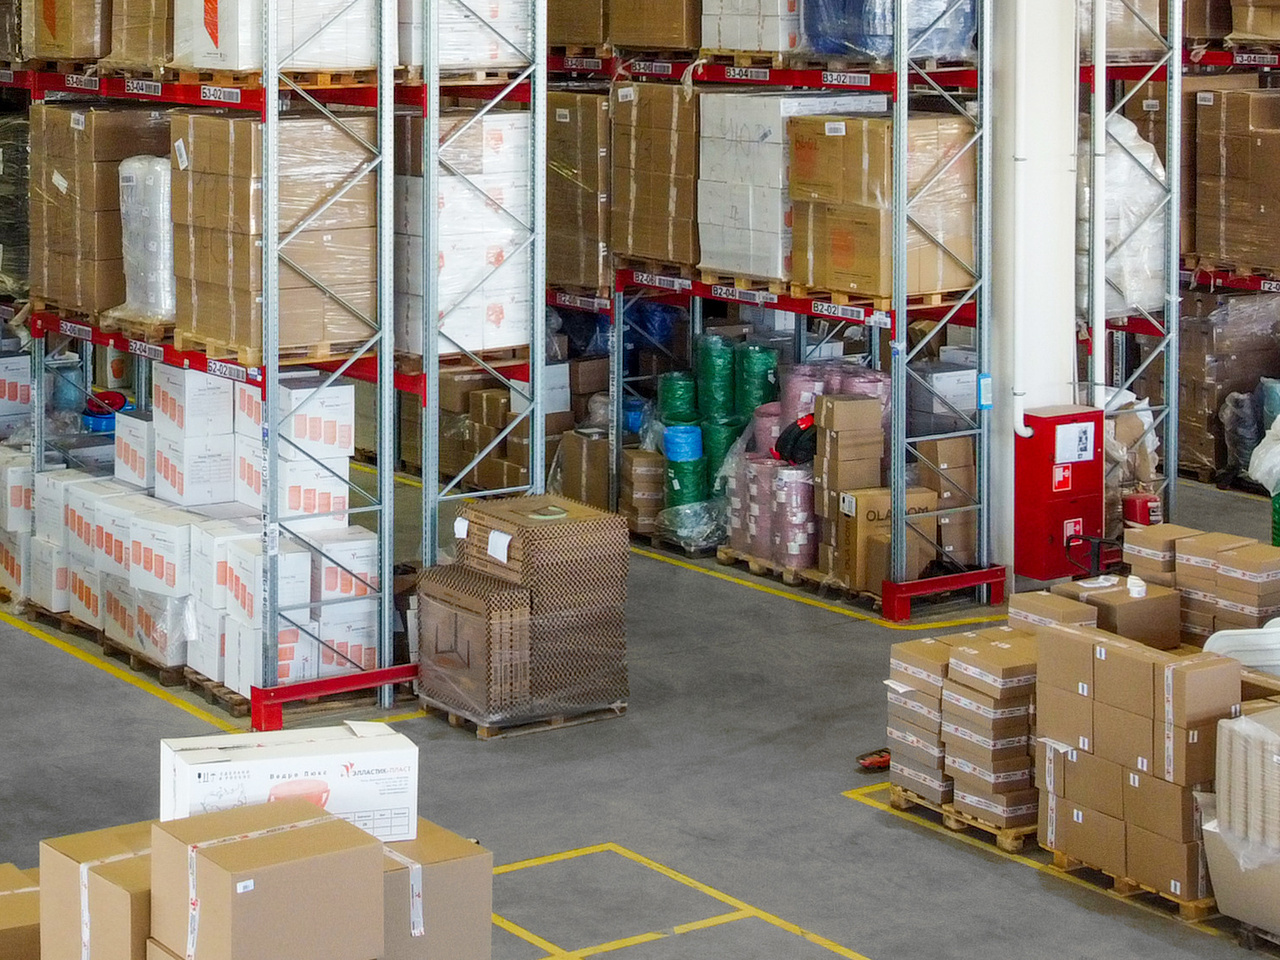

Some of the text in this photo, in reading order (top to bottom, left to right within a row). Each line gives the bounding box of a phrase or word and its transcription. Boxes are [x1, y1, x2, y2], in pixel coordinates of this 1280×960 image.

[126, 81, 145, 93] Б3-04
[202, 87, 222, 100] Б3-02
[712, 285, 736, 298] В2-04
[813, 301, 838, 315] В2-02
[129, 340, 148, 355] Б2-04
[207, 361, 228, 377] Б2-02
